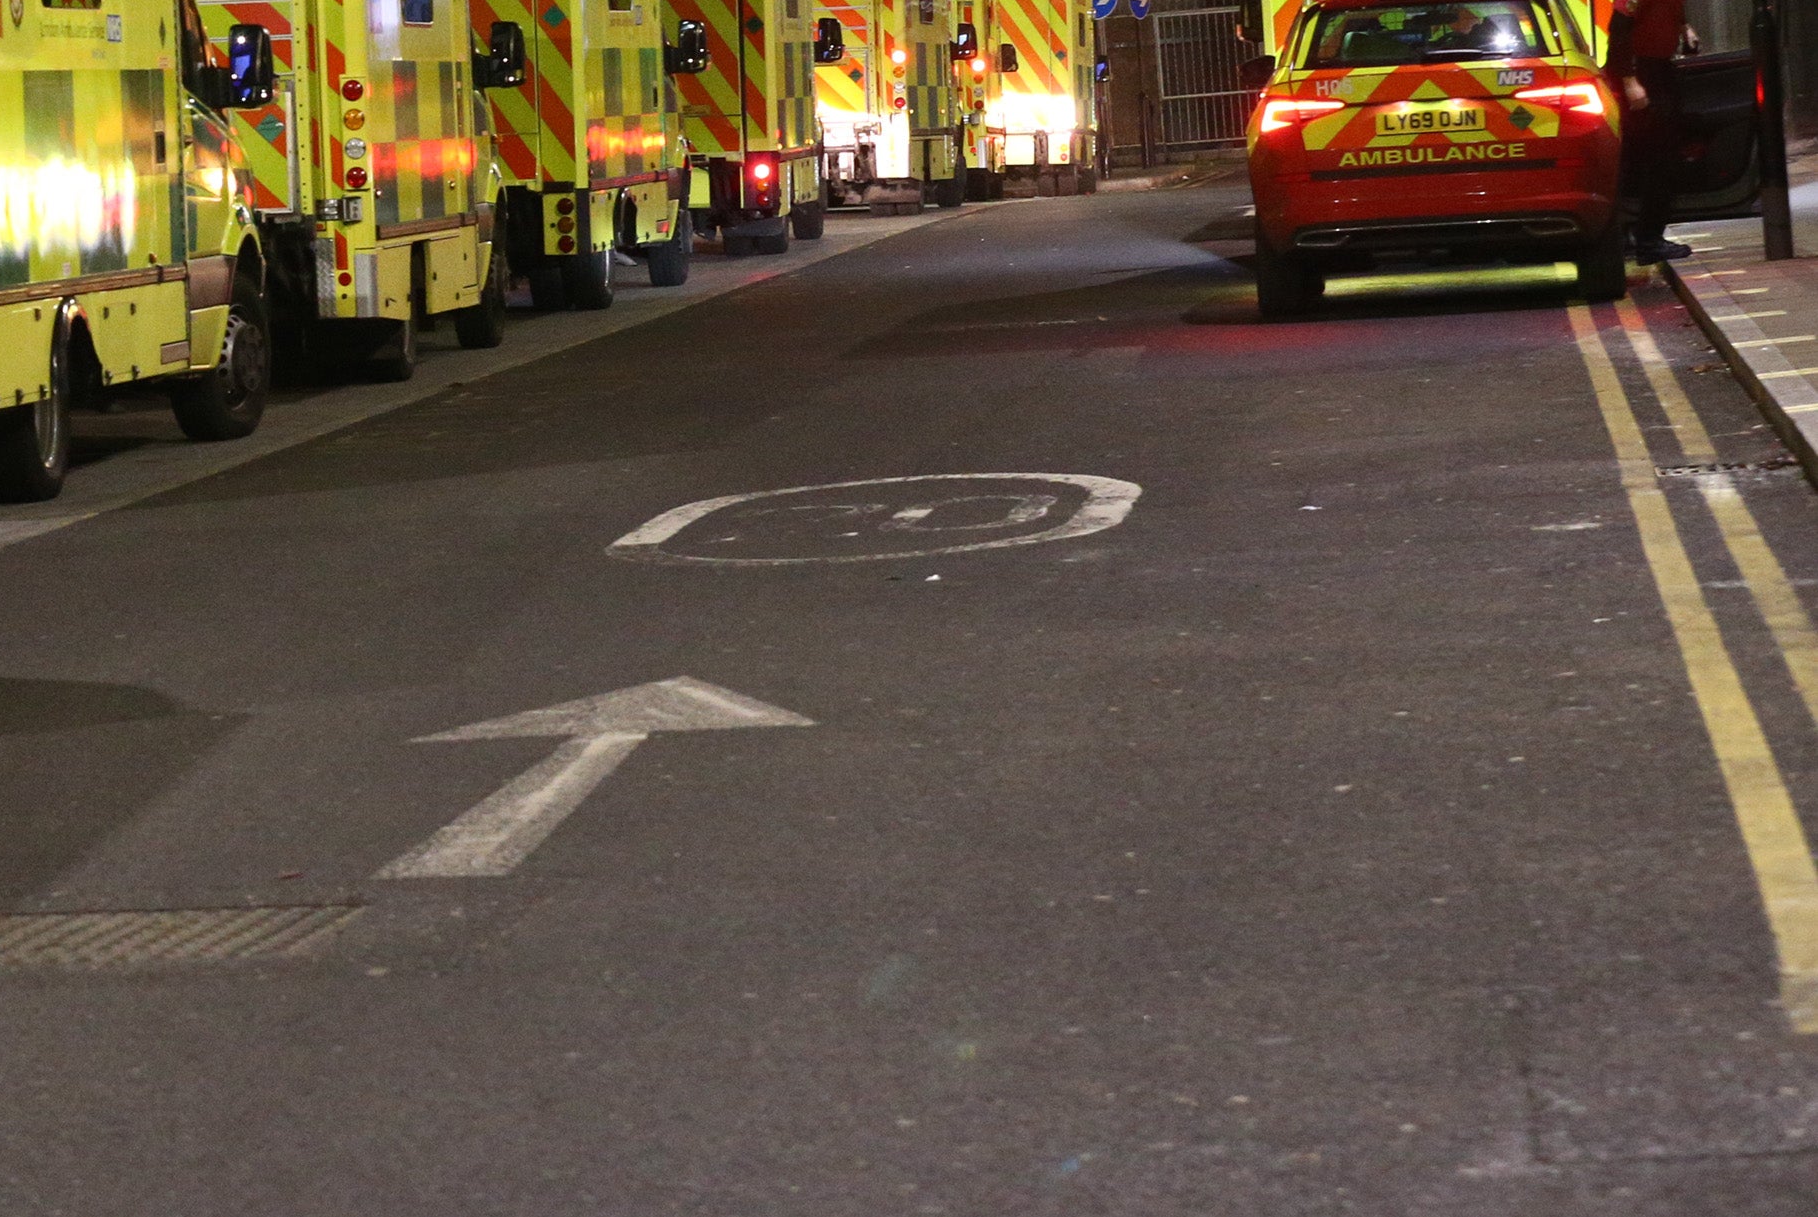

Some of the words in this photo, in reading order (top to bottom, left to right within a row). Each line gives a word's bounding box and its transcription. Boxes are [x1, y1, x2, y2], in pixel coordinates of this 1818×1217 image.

[1498, 70, 1533, 85] NHS
[1384, 112, 1433, 131] LY69
[1440, 110, 1477, 127] OJN
[1339, 143, 1526, 167] AMBULANCE
